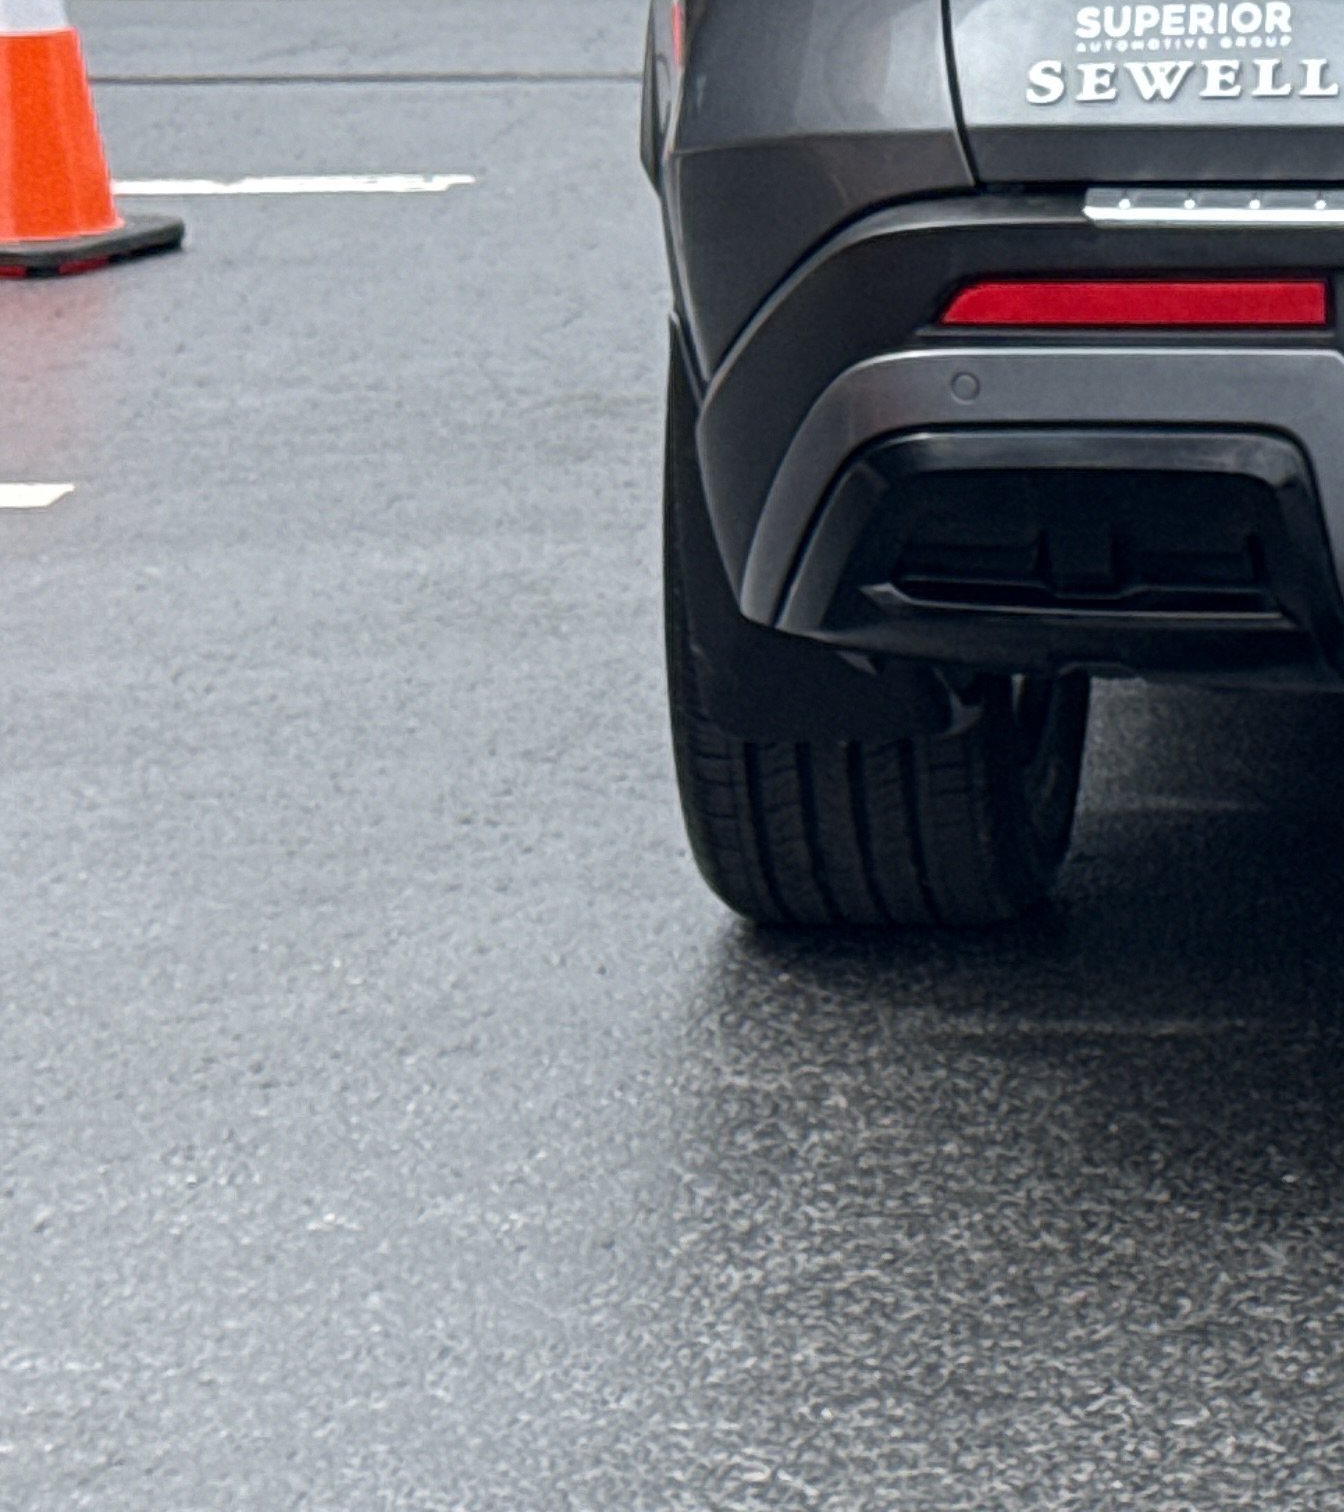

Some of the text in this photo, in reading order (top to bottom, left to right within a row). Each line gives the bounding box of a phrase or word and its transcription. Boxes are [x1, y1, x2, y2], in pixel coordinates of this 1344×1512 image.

[1075, 1, 1292, 38] SUPERIOR
[1076, 35, 1292, 53] AUTOMOTIVE GROUP
[1026, 58, 1339, 104] SEWELL
